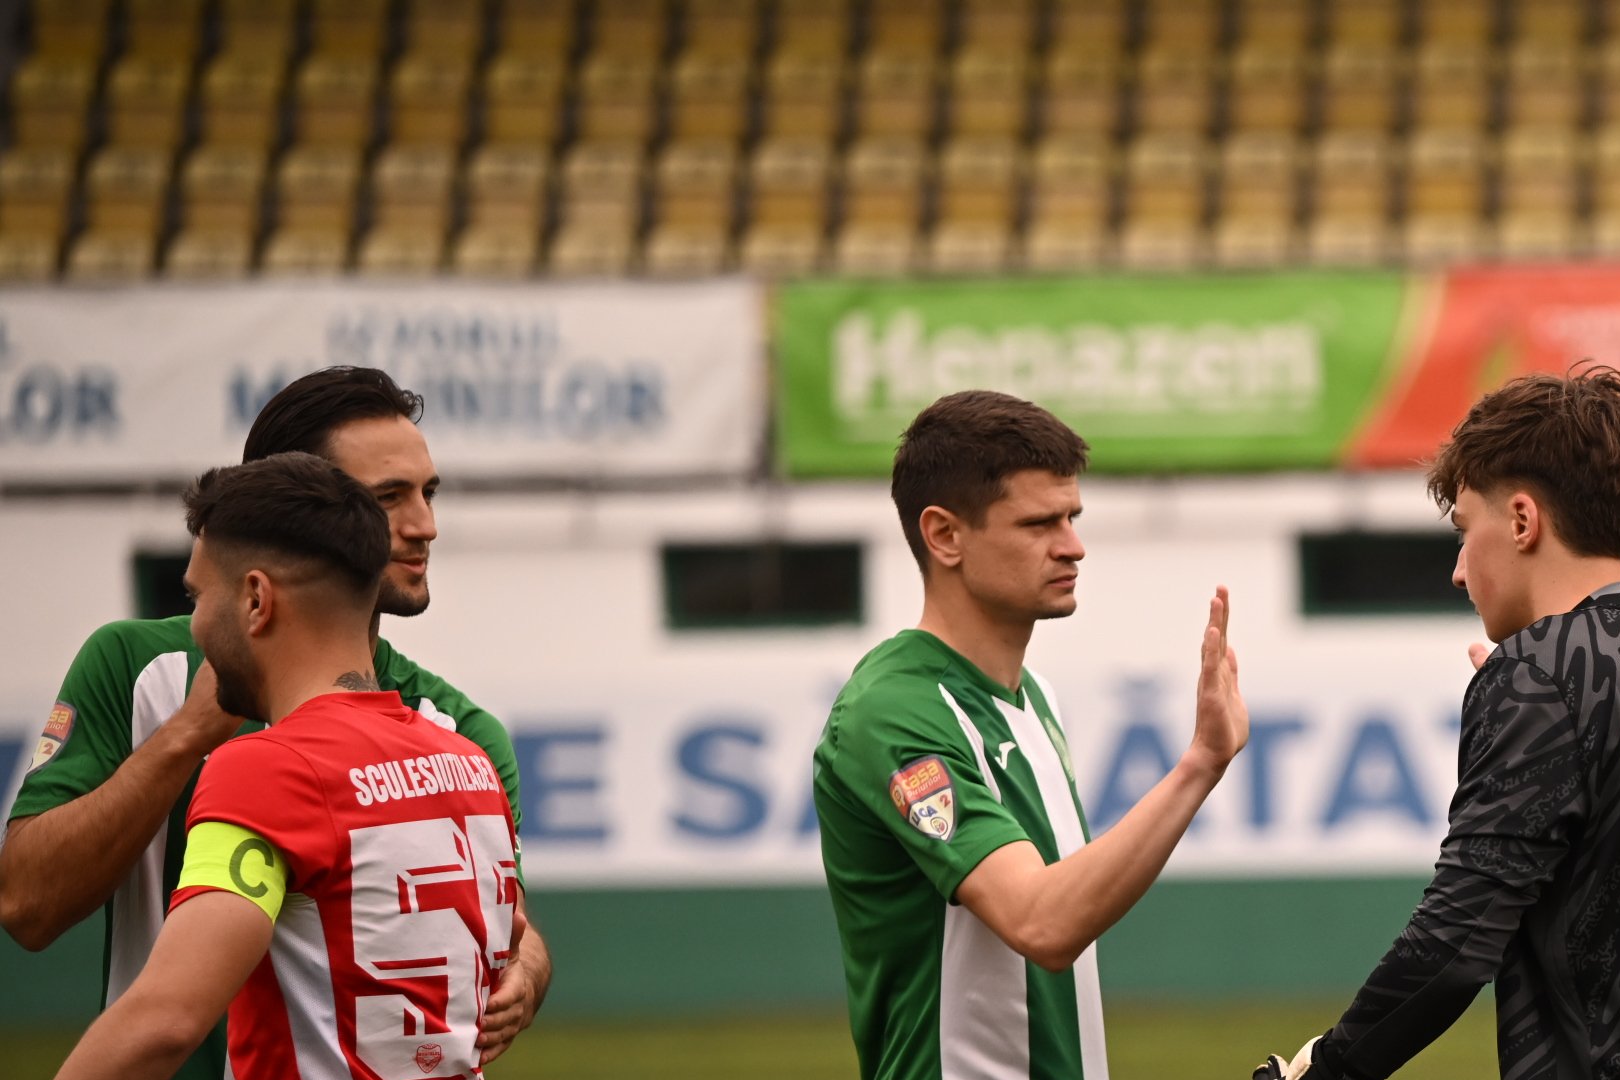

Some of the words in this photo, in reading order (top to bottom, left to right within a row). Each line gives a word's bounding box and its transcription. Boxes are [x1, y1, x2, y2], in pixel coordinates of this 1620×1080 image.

[41, 742, 54, 756] 2
[939, 794, 952, 809] 2
[229, 837, 274, 898] C
